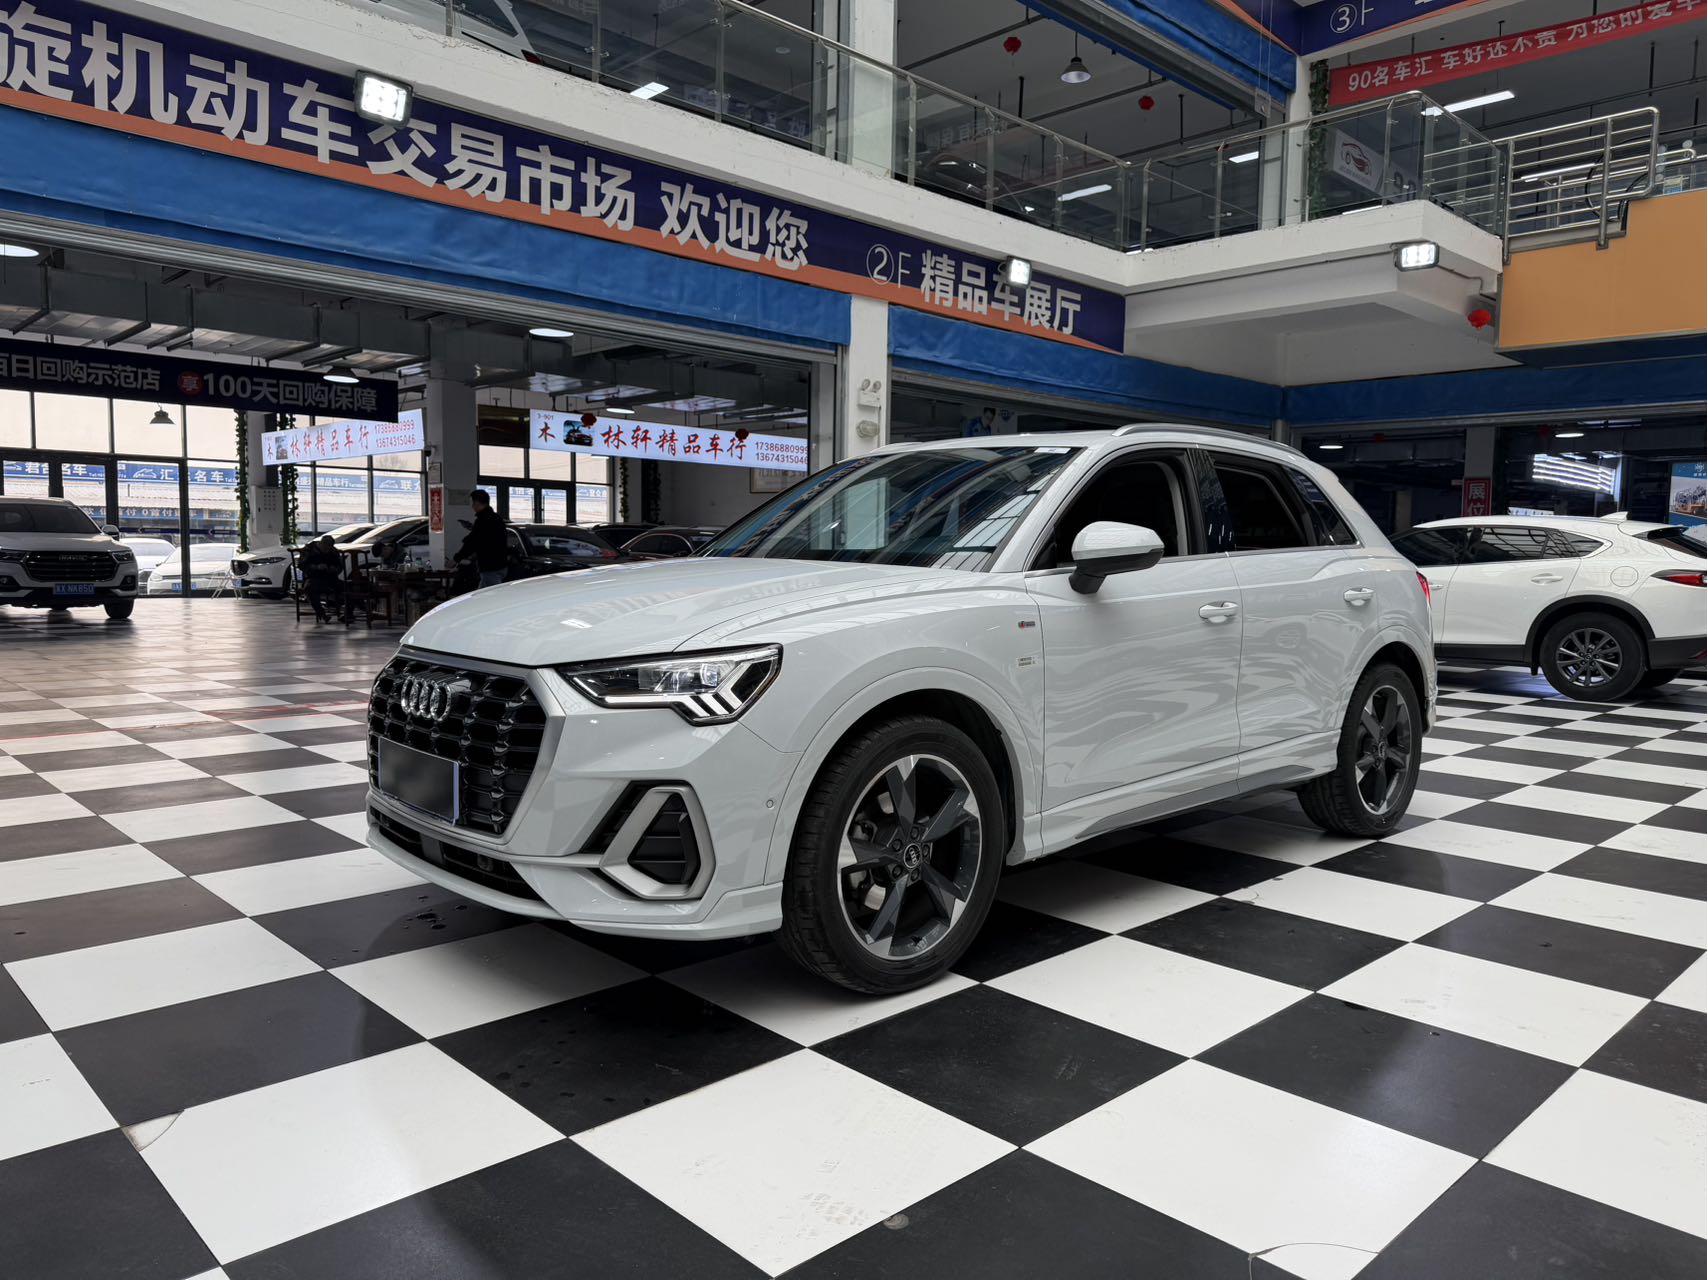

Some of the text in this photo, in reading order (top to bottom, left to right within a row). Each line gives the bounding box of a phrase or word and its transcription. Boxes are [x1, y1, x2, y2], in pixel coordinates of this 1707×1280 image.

[1348, 56, 1433, 91] 90名车汇
[660, 181, 809, 271] 欢迎您
[920, 249, 1082, 335] 精品车展厅
[203, 373, 377, 412] 100天回购保障
